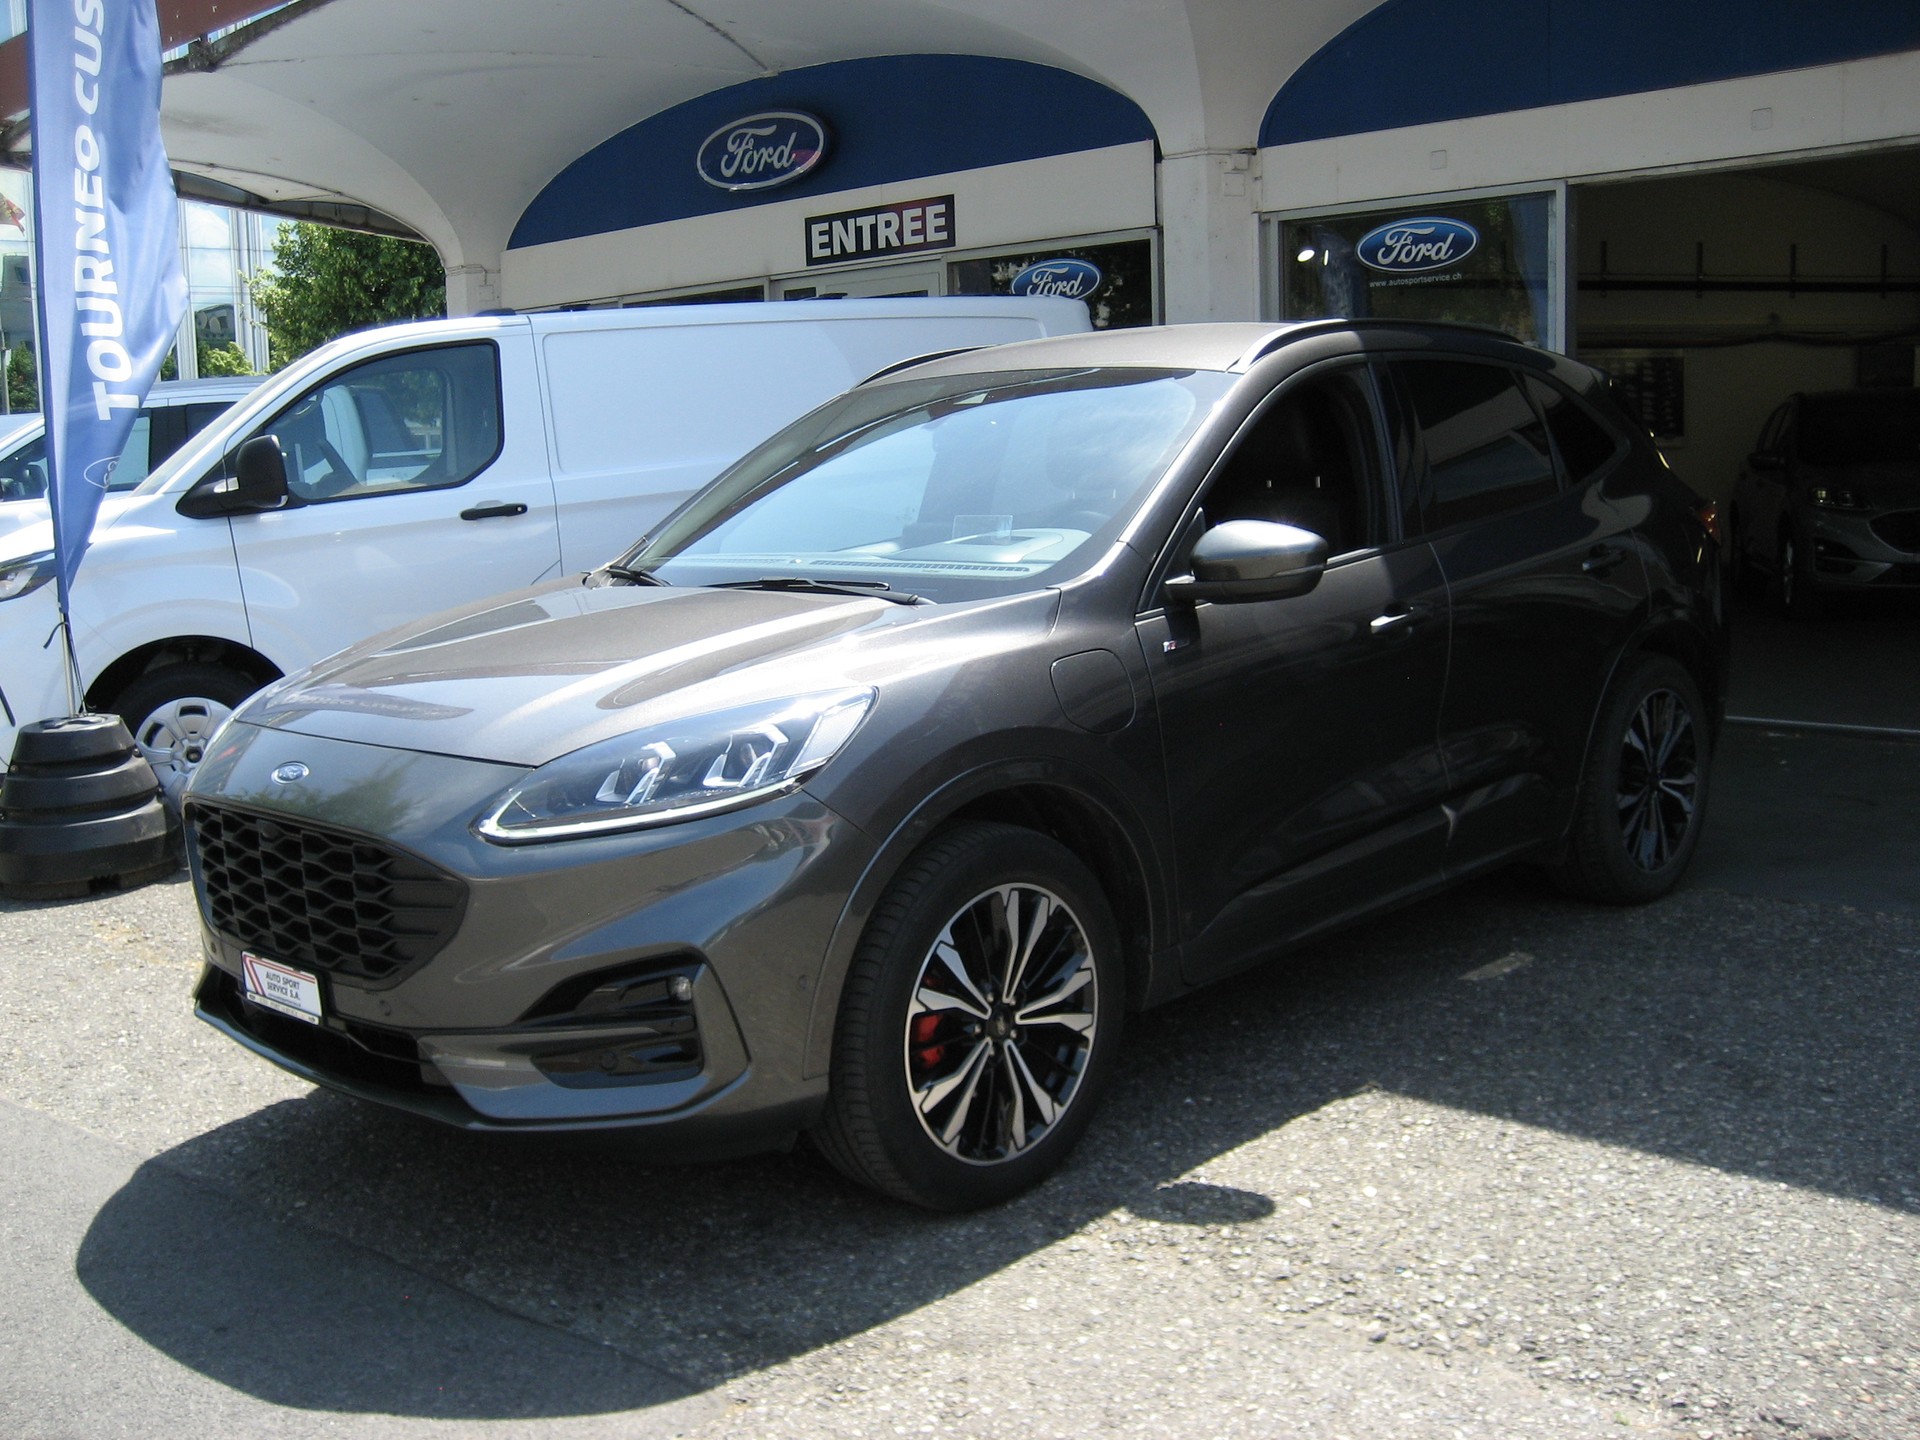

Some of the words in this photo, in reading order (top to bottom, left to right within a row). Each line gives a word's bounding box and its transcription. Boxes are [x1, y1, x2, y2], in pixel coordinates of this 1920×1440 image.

[721, 125, 797, 178] Ford
[811, 204, 948, 258] ENTREE
[1377, 226, 1454, 265] Ford
[75, 125, 139, 421] TOURNEO
[1026, 266, 1084, 297] Ford
[1369, 272, 1462, 288] www.autosportservice.ch
[266, 971, 281, 983] AUTO
[282, 977, 300, 990] SPORT
[267, 981, 288, 996] SERVICE
